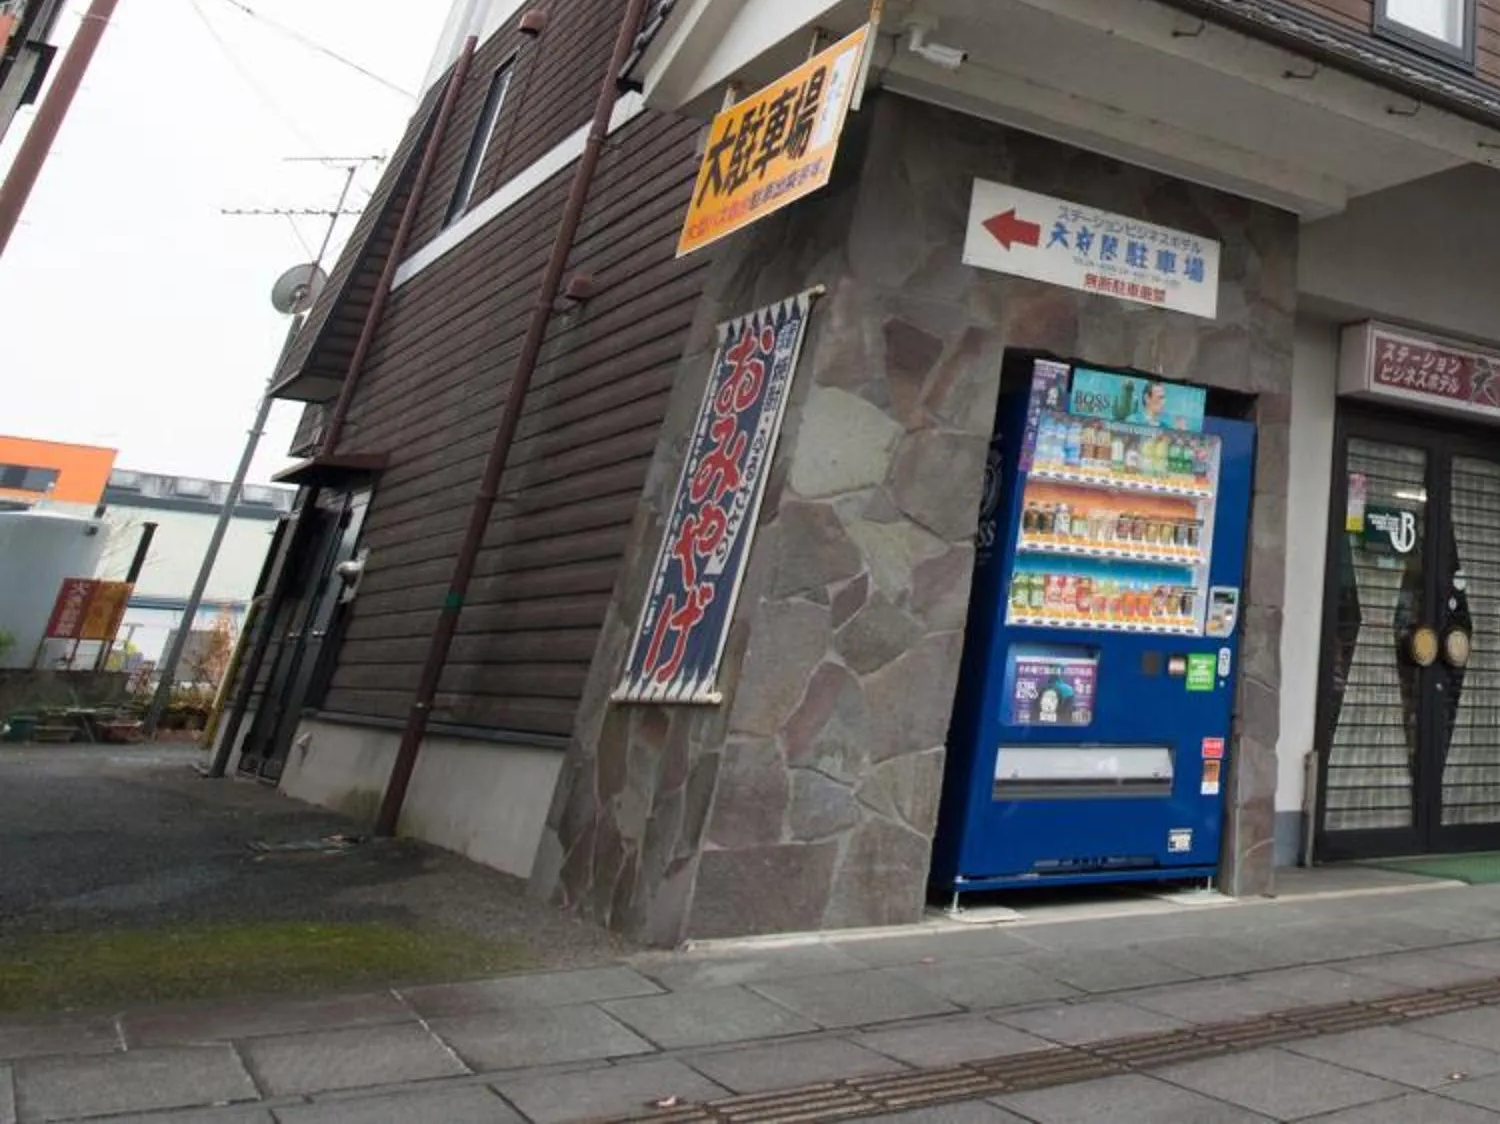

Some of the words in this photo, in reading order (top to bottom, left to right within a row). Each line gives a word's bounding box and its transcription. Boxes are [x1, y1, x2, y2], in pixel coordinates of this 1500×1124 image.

[696, 64, 827, 209] 大駐車場
[1057, 205, 1203, 253] ステーションビジネスホテル
[1380, 342, 1463, 374] ステーション
[1074, 389, 1111, 408] BOSS
[1380, 363, 1462, 394] ビジネスホテル
[644, 323, 777, 684] おみやげ
